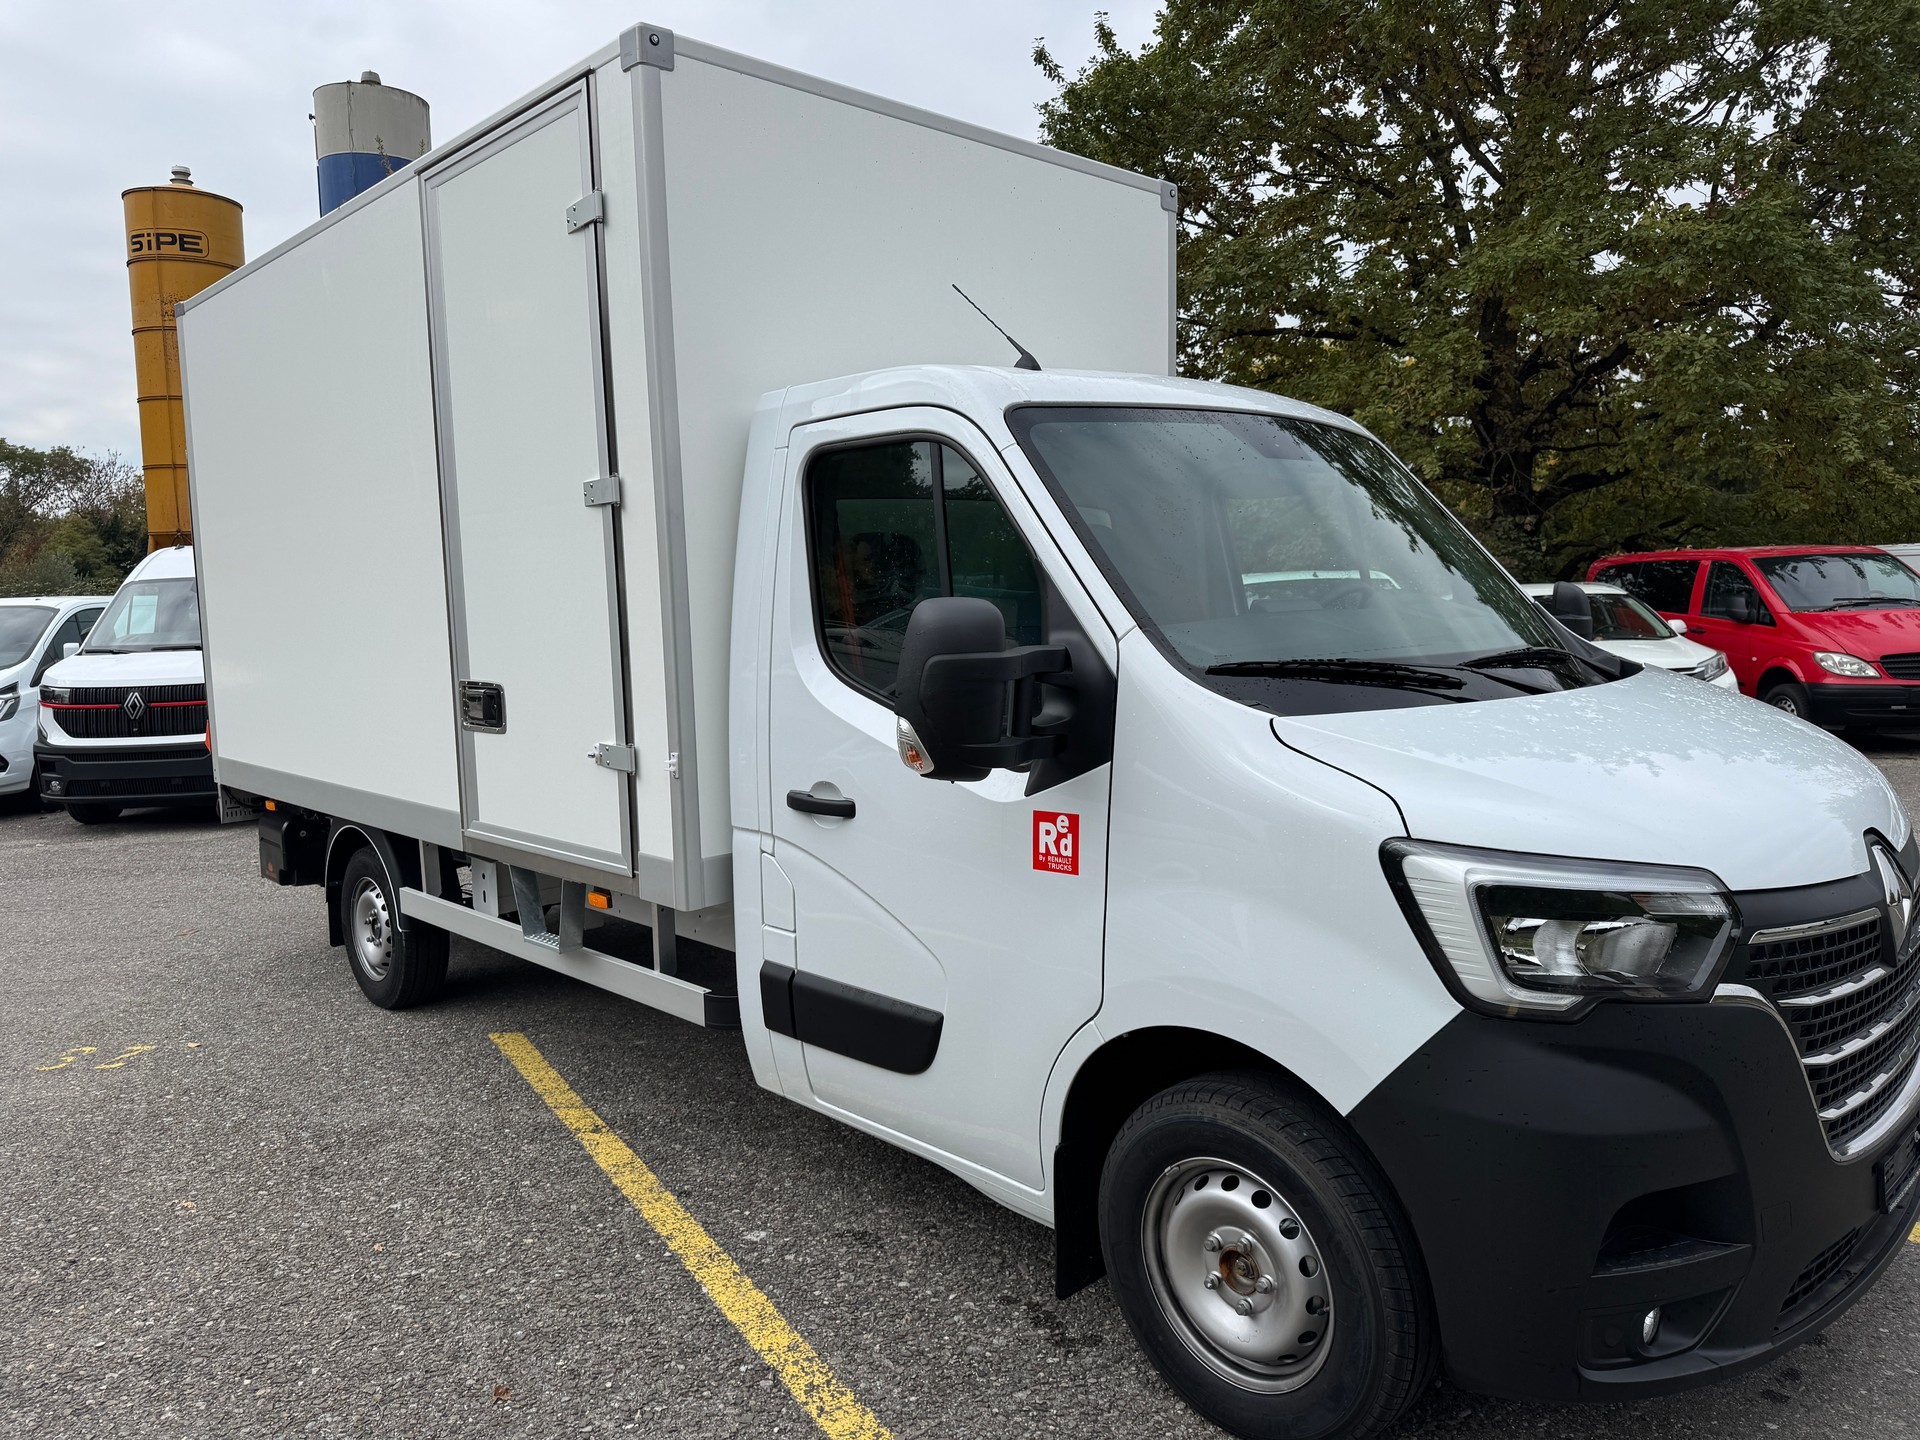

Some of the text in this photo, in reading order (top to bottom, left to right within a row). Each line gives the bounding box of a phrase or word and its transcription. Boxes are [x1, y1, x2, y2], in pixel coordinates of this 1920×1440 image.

[1039, 815, 1072, 857] Red
[1048, 855, 1072, 865] RENAULT
[1048, 862, 1072, 872] TRUCKS
